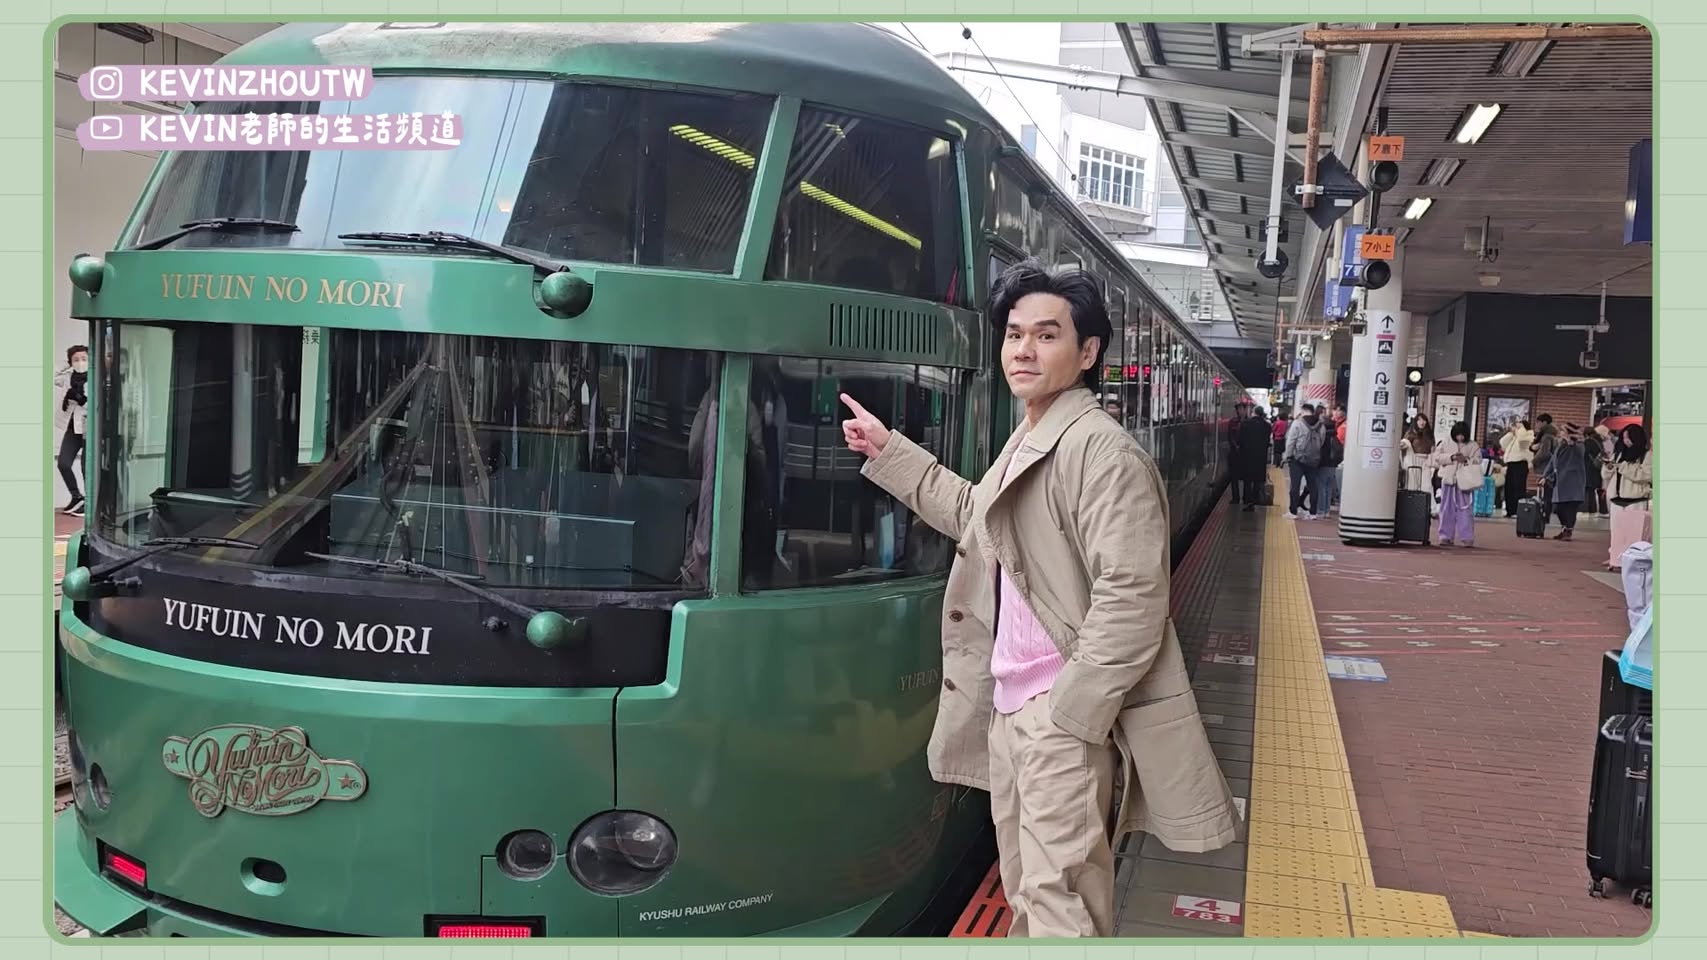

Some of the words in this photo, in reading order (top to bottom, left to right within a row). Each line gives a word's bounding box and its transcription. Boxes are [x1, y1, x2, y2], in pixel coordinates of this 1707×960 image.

[1364, 241, 1392, 254] 7小上
[160, 272, 256, 302] YUFUIN
[266, 277, 308, 305] NO
[316, 279, 406, 309] MORI
[162, 596, 268, 641] YUFUIN
[275, 615, 324, 648] NO
[333, 620, 433, 656] MORI
[639, 907, 684, 922] KYUSHU
[684, 901, 727, 917] RAILWAY
[728, 893, 774, 911] COMPANY
[1194, 899, 1221, 911] 4
[1182, 909, 1231, 923] 783
